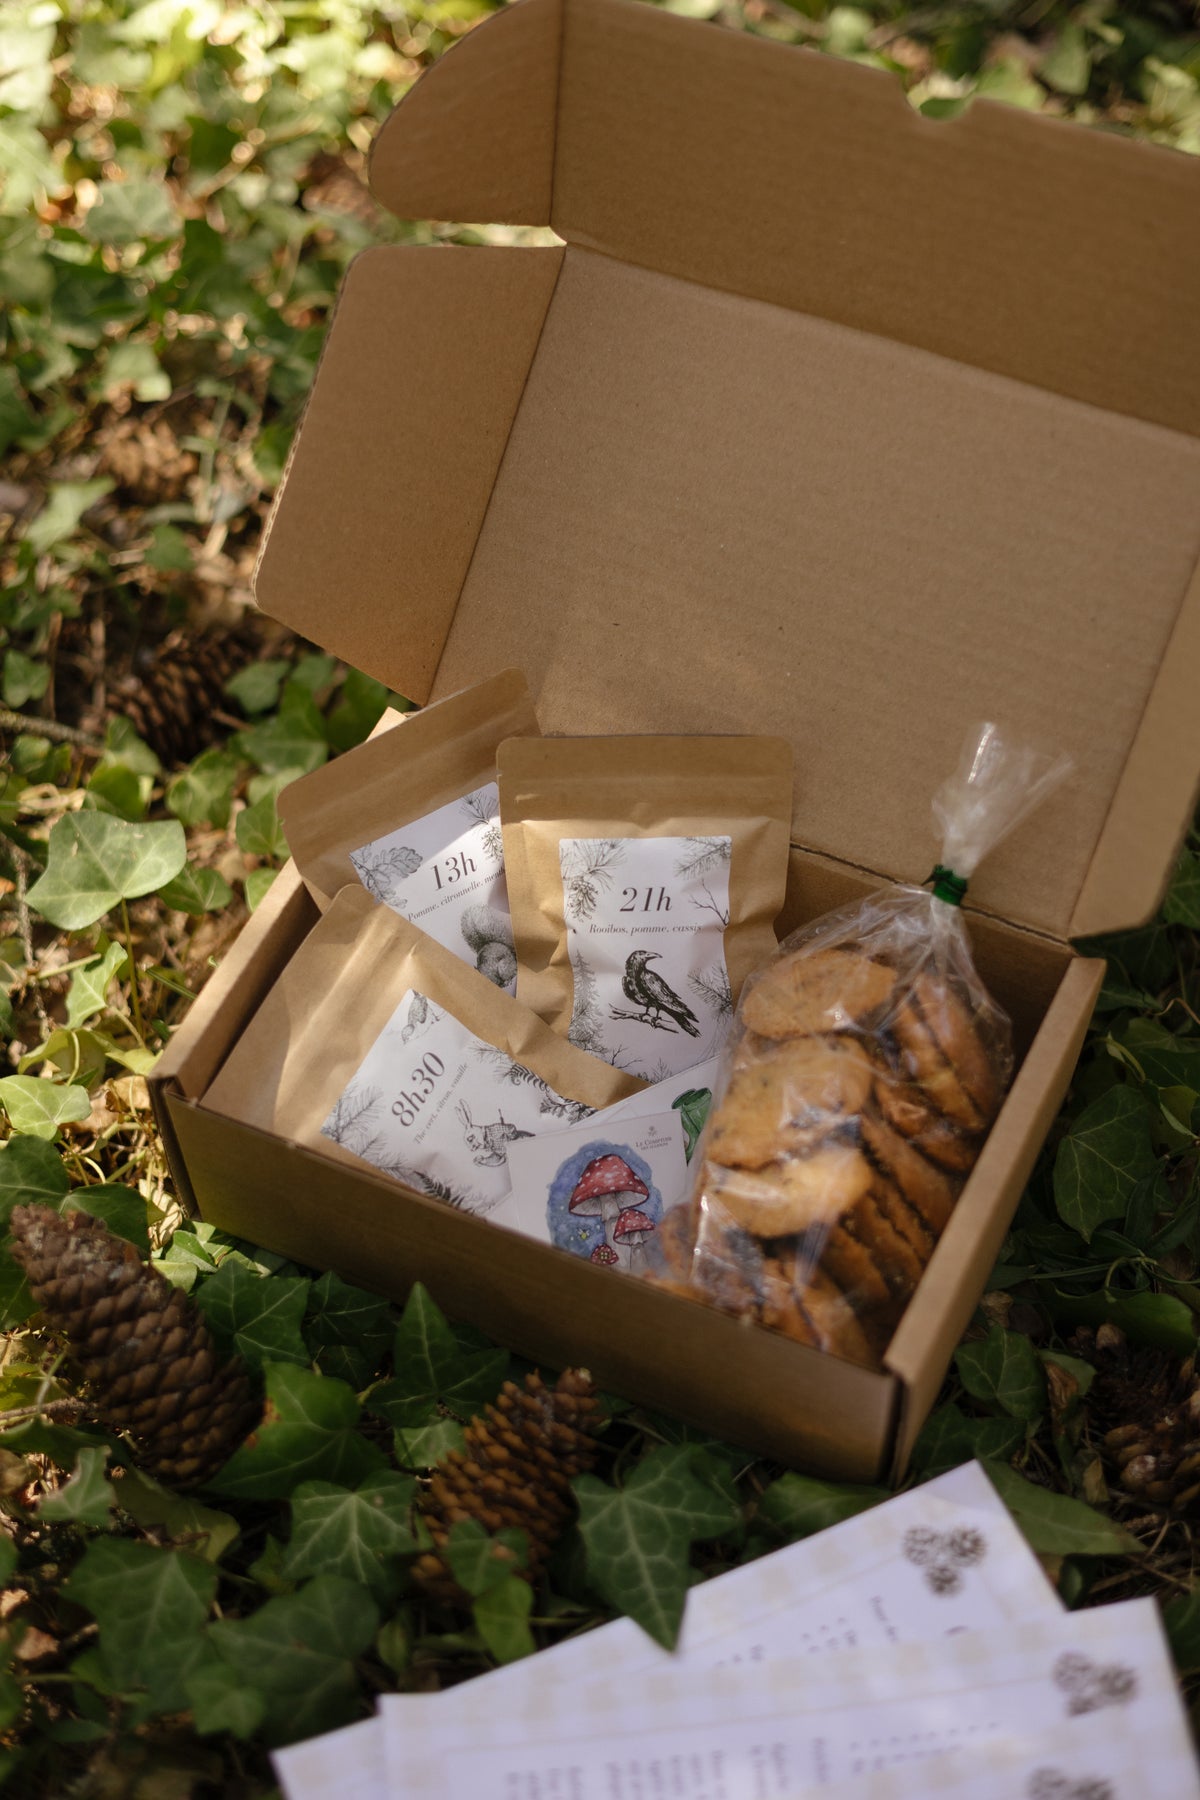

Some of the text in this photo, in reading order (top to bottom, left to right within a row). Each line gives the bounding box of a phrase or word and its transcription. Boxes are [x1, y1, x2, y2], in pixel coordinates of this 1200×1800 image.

[430, 851, 477, 891] 13h
[407, 866, 506, 922] Pomme, citronnelle, menth
[619, 886, 673, 912] 21h
[589, 922, 703, 937] Rooibos, pomme, cassis
[391, 1052, 445, 1127] 8h30
